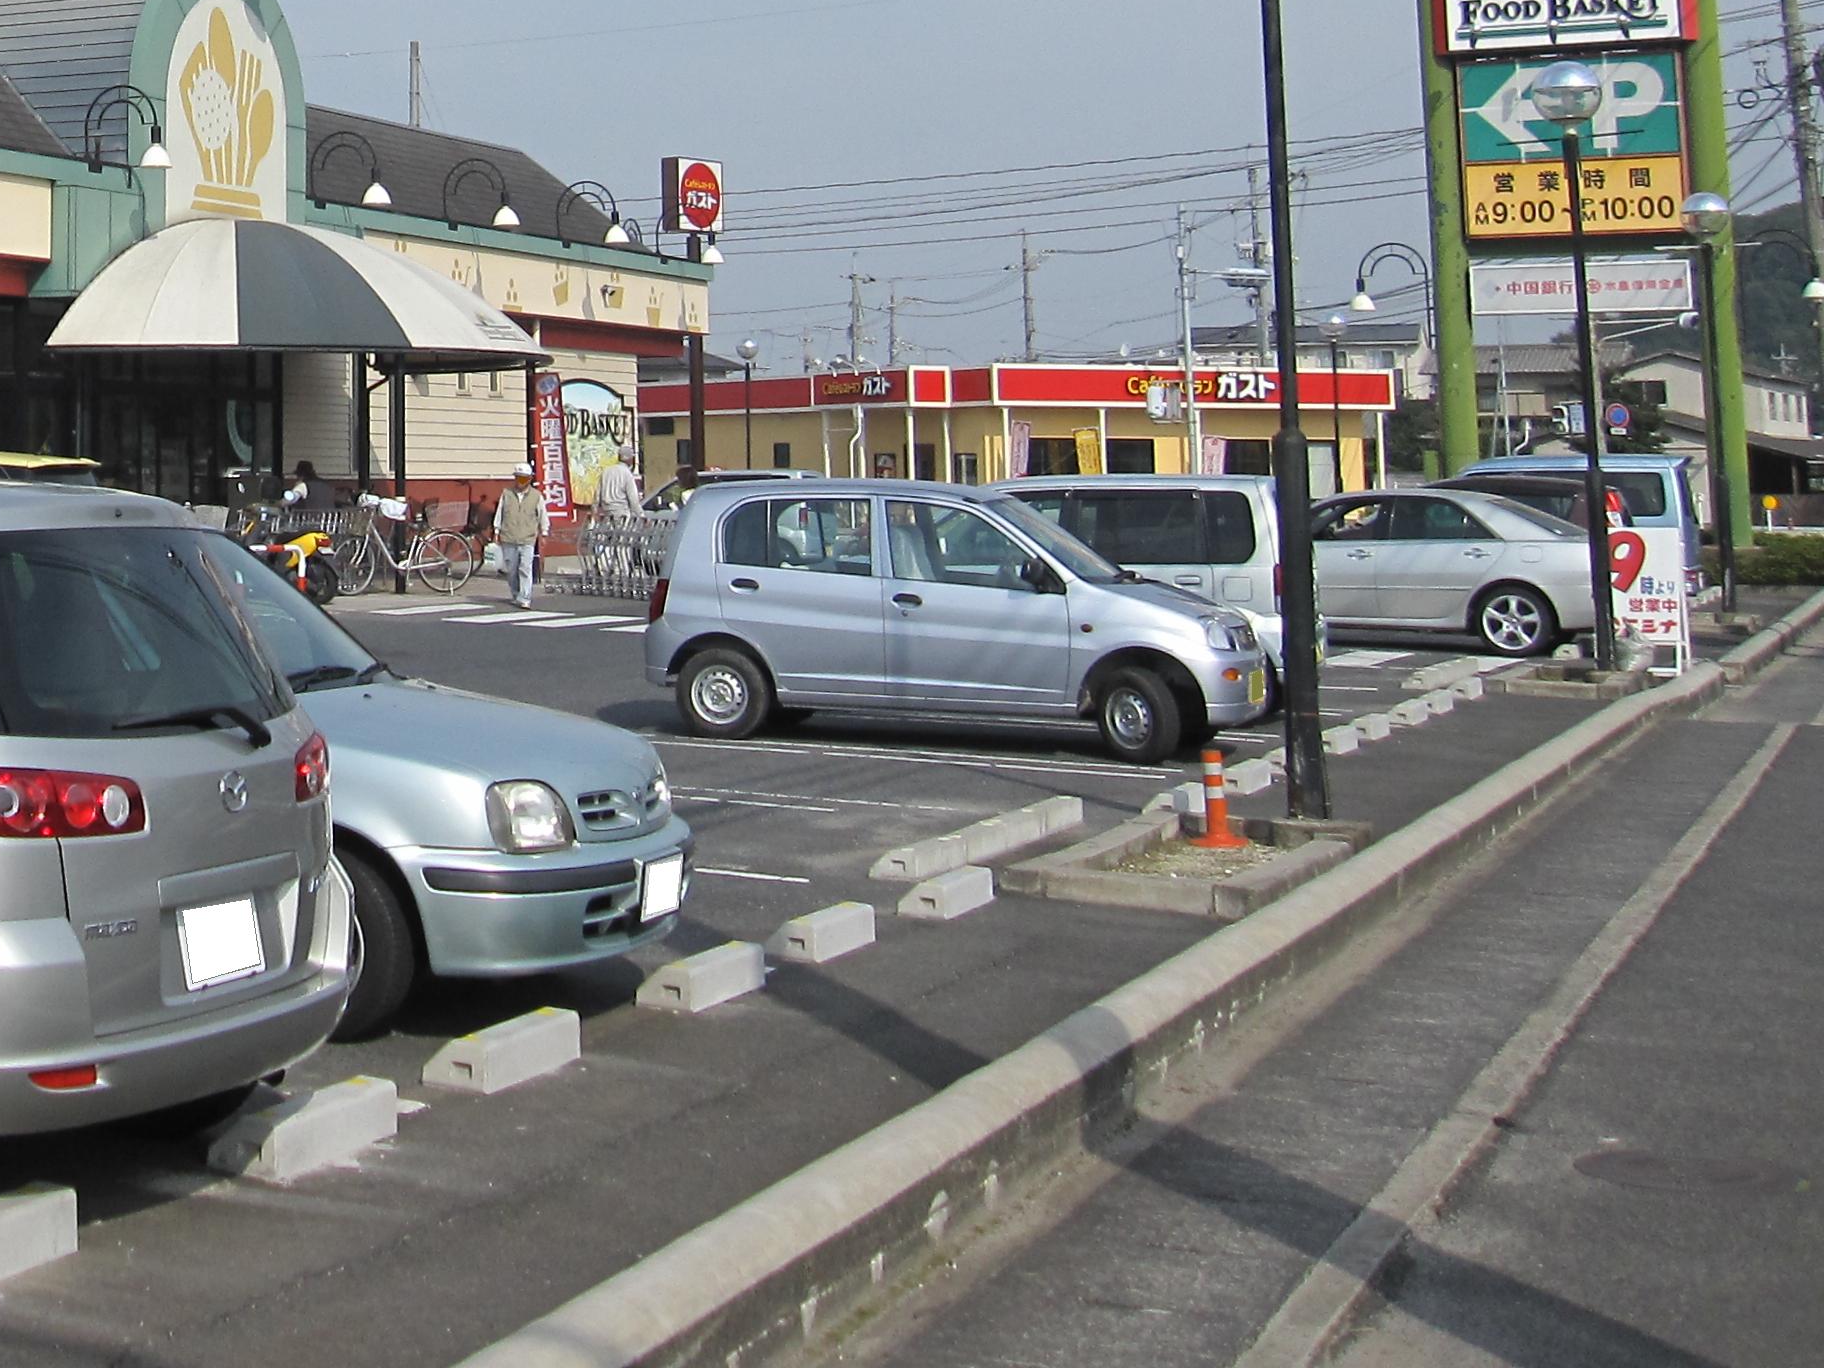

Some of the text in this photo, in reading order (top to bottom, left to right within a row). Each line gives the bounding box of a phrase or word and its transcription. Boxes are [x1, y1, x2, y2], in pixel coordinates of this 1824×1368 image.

[1493, 168, 1651, 193] 営業時間
[1492, 200, 1555, 224] 9:00
[1600, 195, 1675, 220] 10:00
[1506, 280, 1573, 296] 中国銀行
[1217, 372, 1276, 399] ガスト
[1628, 597, 1678, 613] 営業中
